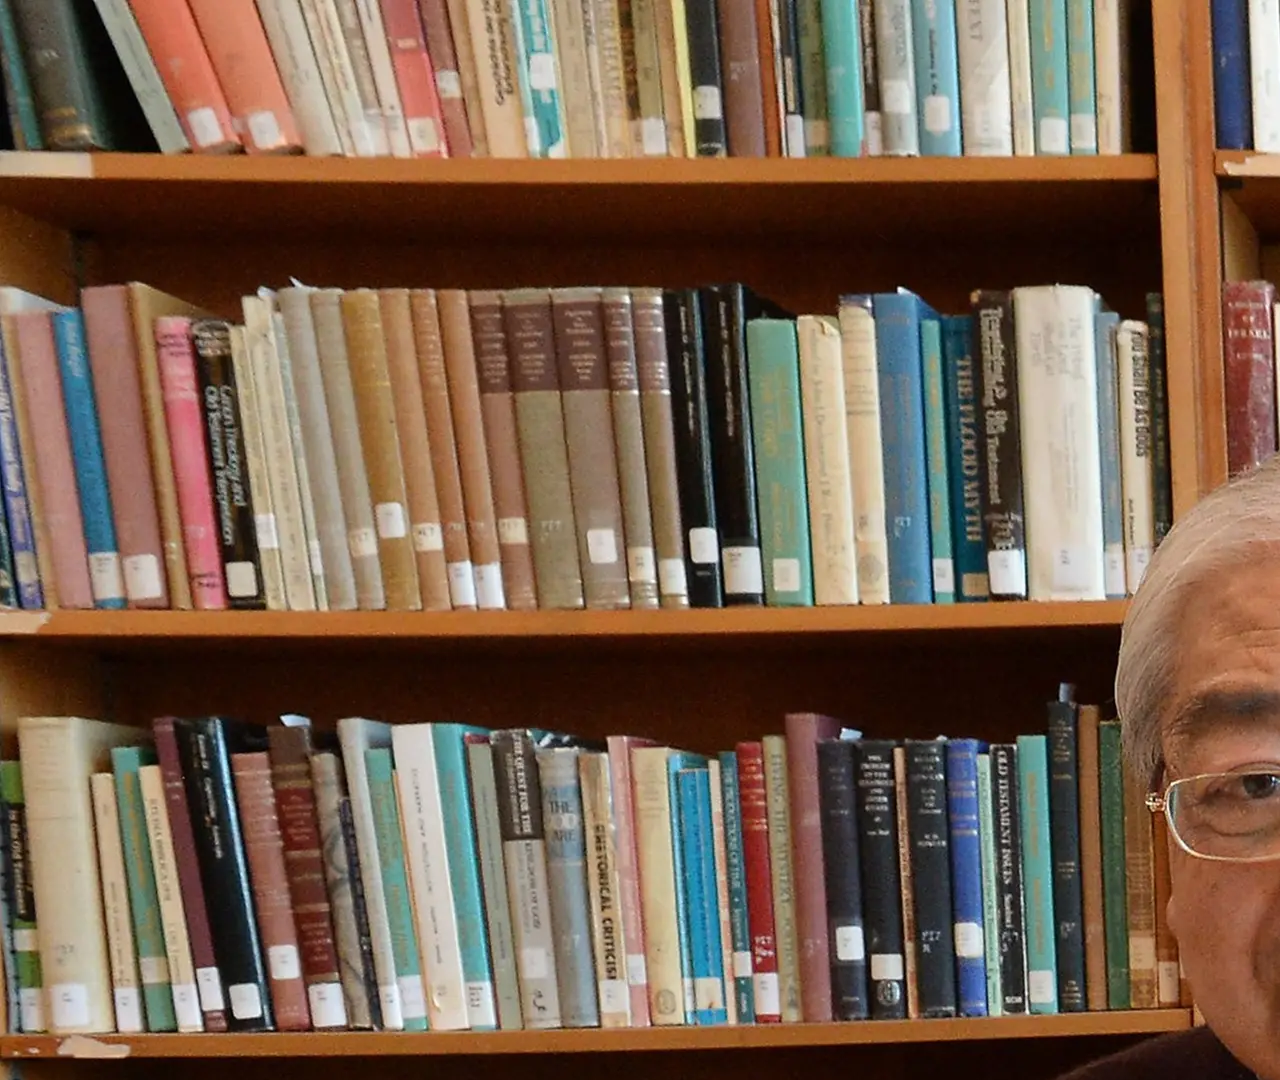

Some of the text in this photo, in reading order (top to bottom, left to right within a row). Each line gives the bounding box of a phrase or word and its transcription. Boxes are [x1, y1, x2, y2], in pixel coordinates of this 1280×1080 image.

[955, 355, 982, 542] THE FLOOD MYTH
[513, 757, 526, 790] QUEST
[996, 750, 1010, 776] OLD
[517, 792, 529, 812] FOR
[998, 779, 1013, 845] TESTAMENT
[520, 815, 532, 834] THE
[593, 824, 614, 912] RHETORICAL
